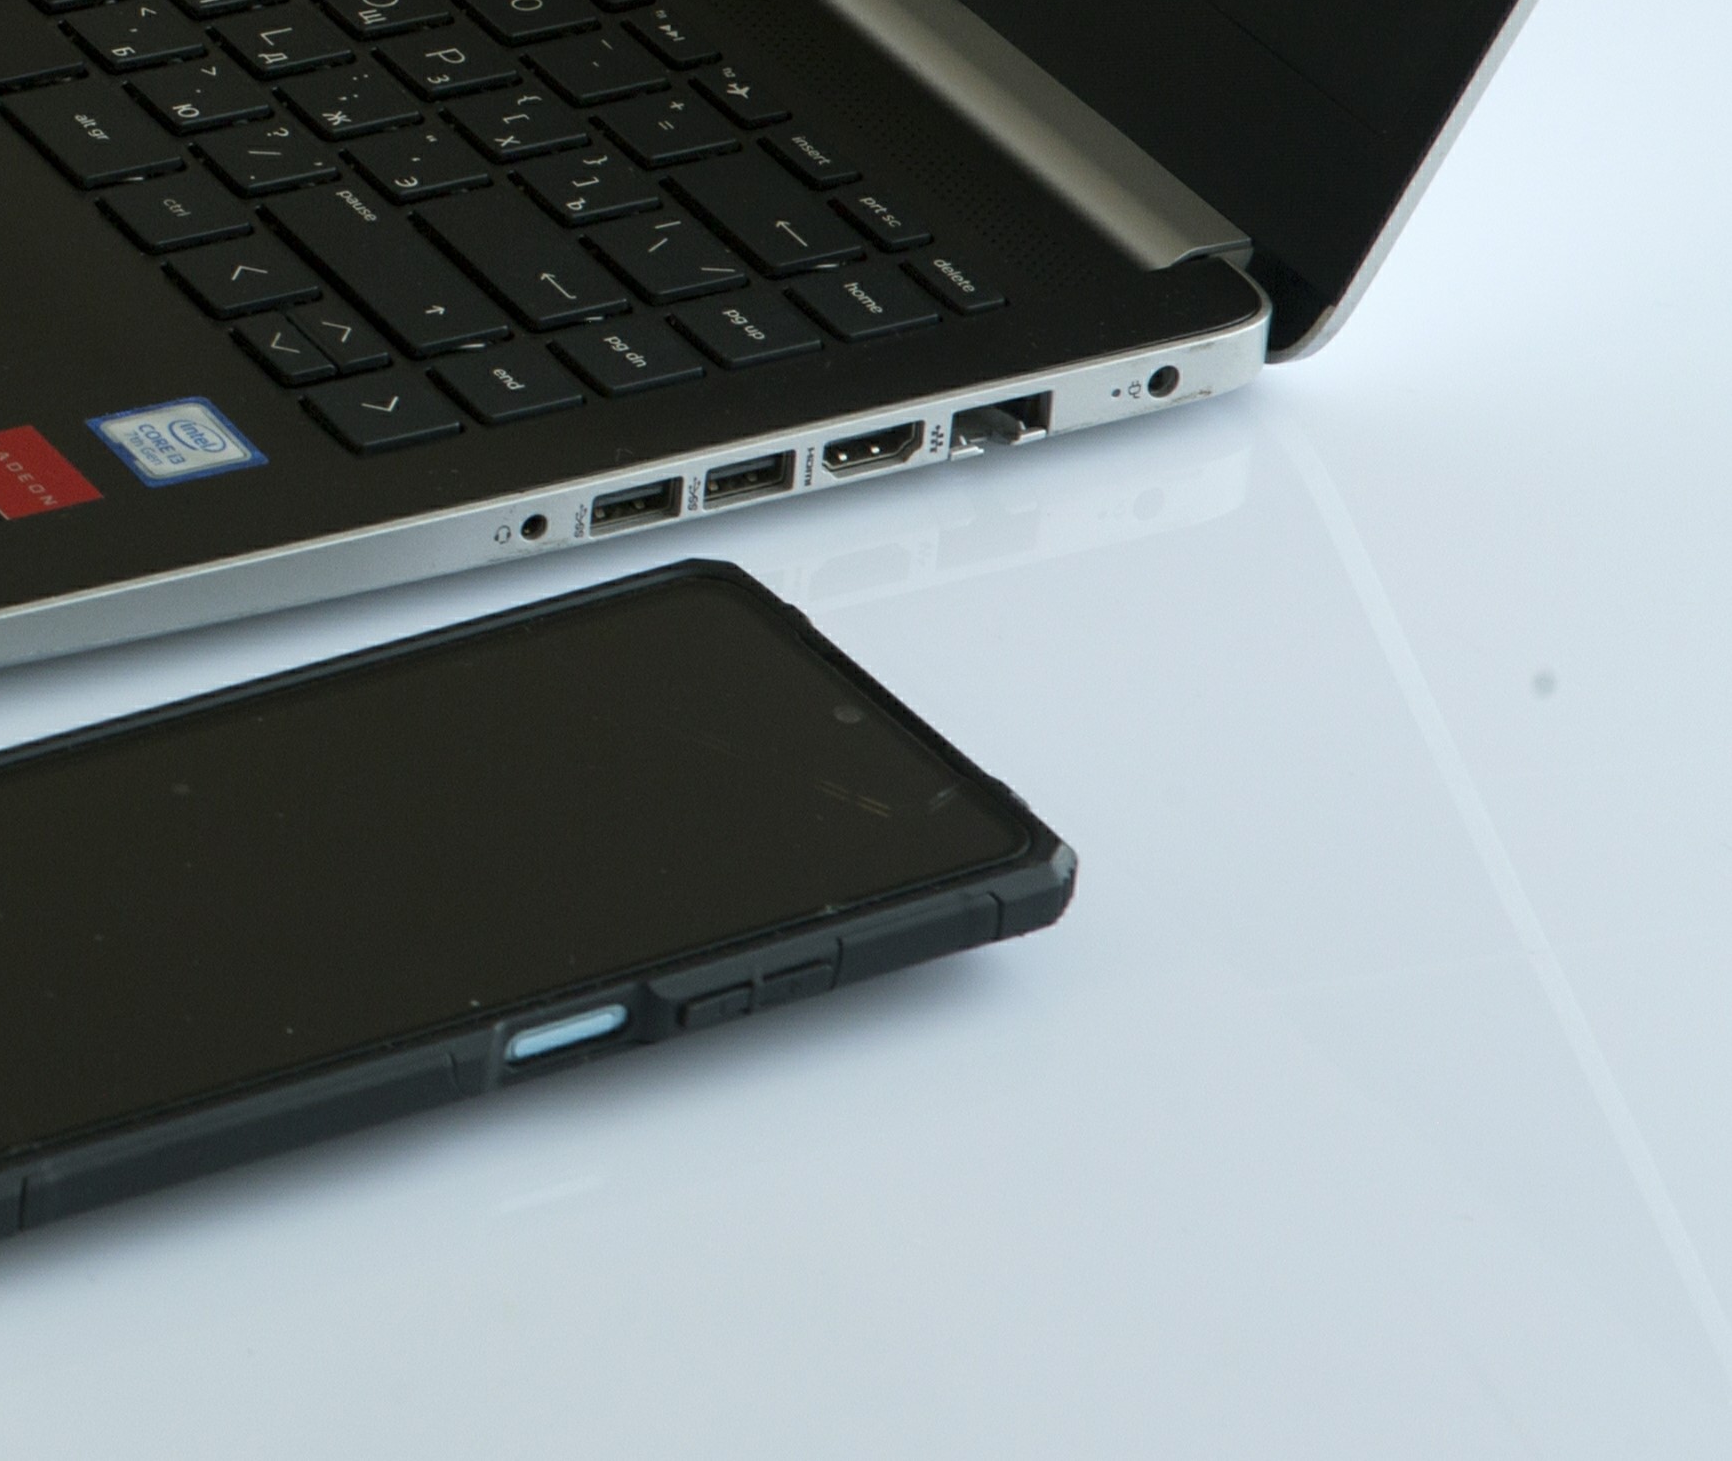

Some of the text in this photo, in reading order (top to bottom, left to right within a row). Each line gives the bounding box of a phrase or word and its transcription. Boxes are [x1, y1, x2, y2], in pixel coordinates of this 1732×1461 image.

[358, 9, 387, 26] Щ
[259, 27, 293, 46] L
[112, 46, 136, 58] Б
[258, 51, 288, 64] Д
[425, 47, 466, 64] P
[172, 103, 200, 118] Ю
[322, 111, 351, 125] Ж
[74, 113, 110, 141] alt gr
[495, 135, 521, 149] Х
[791, 136, 831, 165] insert
[394, 176, 419, 190] Э
[163, 198, 191, 217] ctrl
[335, 189, 377, 221] pause
[566, 198, 586, 211] Ъ
[859, 196, 902, 228] prt sc
[932, 258, 976, 293] delete
[843, 281, 883, 314] home
[722, 309, 766, 342] pg up
[603, 335, 648, 369] pg dn
[492, 368, 526, 390] end
[138, 422, 186, 465] CORE i3
[180, 421, 216, 449] intel
[141, 445, 163, 466] Gen
